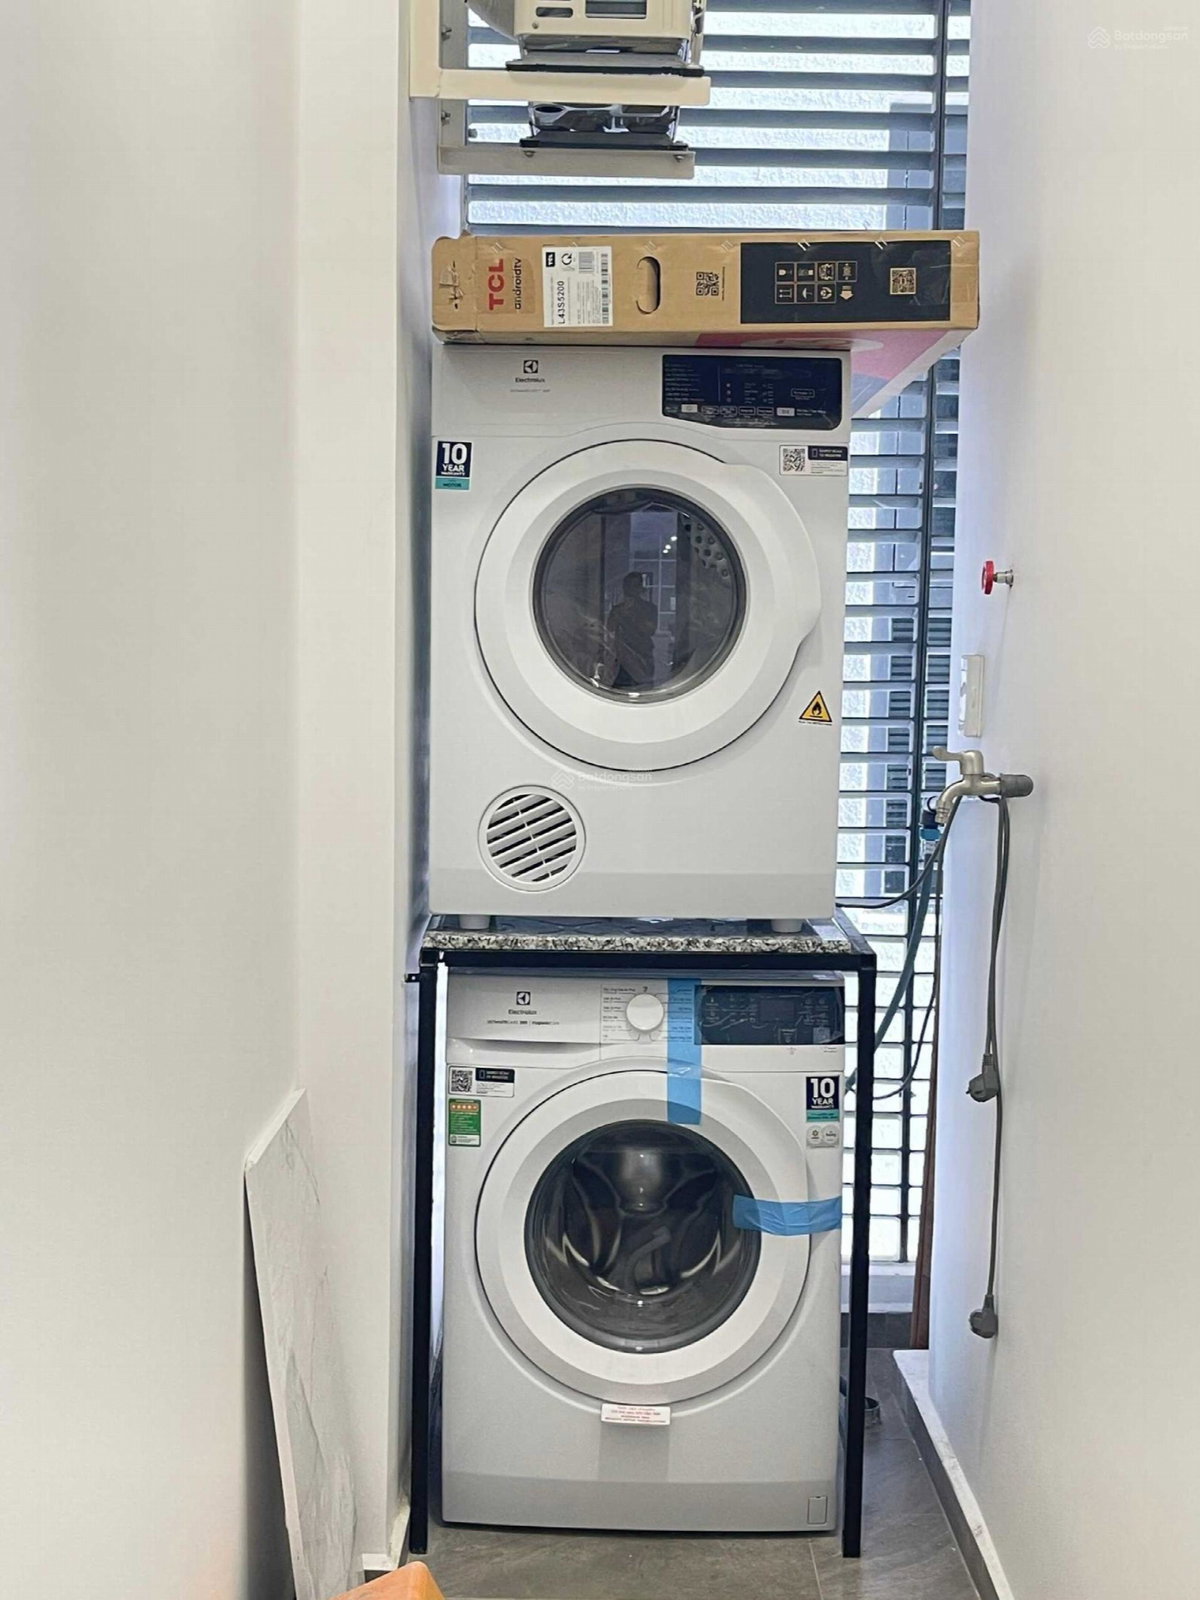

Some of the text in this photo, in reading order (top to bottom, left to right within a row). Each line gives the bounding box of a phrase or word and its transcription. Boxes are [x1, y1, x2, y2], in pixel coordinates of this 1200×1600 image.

[488, 258, 505, 310] TCL
[512, 257, 522, 310] androidtv
[442, 442, 467, 465] 10
[442, 464, 465, 472] YEAR
[810, 1077, 835, 1098] 10
[811, 1097, 834, 1105] YEAR
